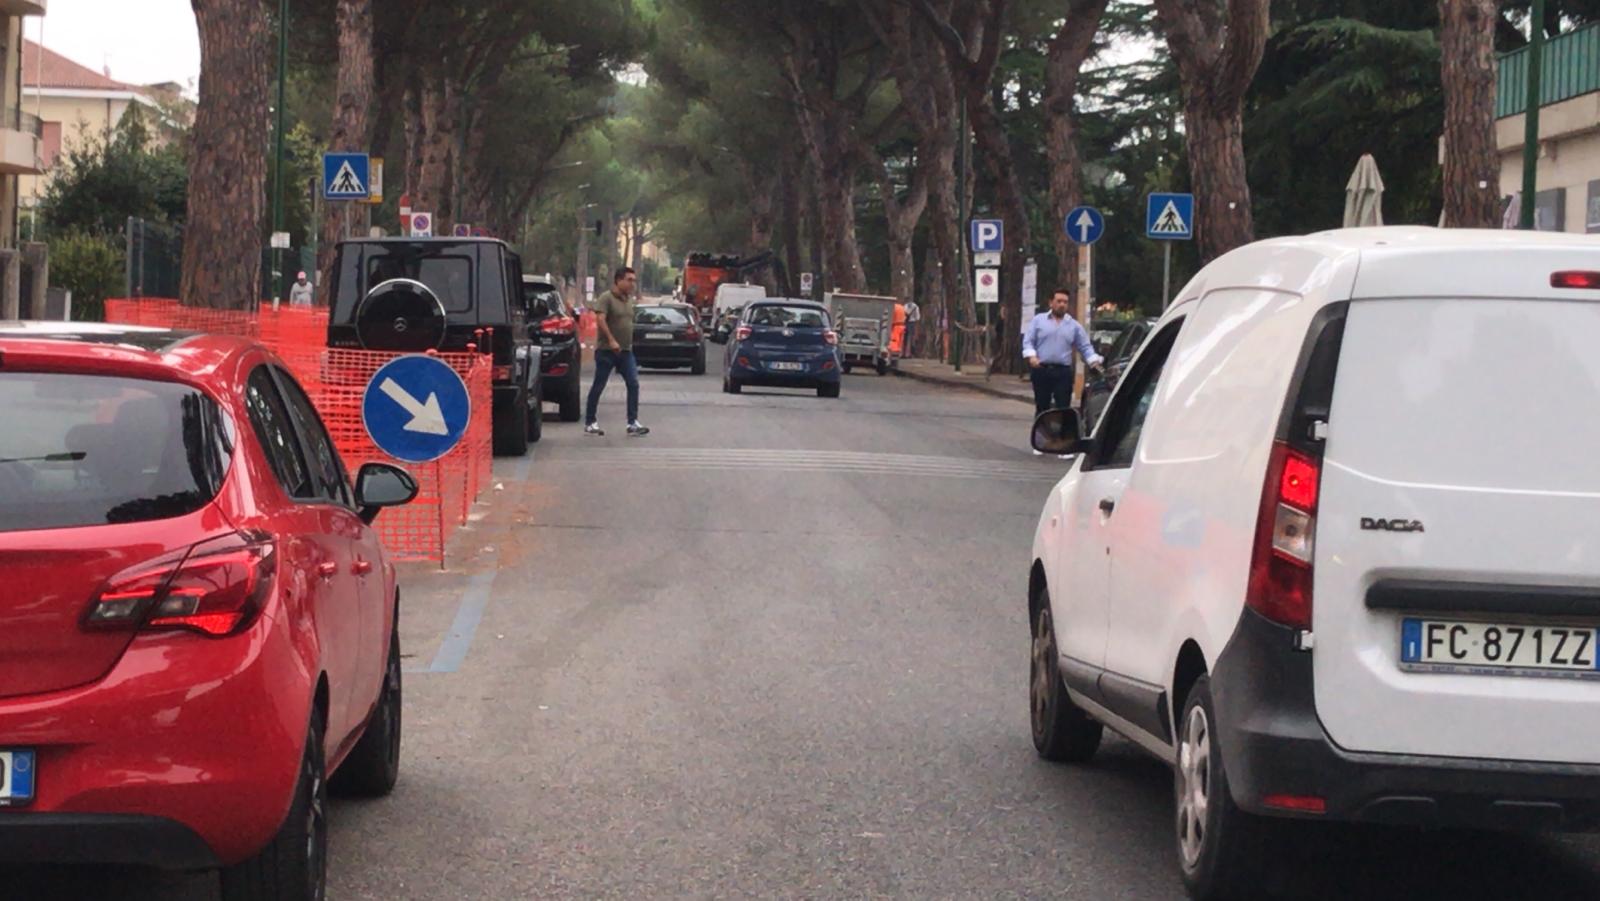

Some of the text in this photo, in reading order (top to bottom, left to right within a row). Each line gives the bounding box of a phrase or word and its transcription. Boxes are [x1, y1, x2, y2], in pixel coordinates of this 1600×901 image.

[978, 223, 998, 249] P
[1360, 517, 1425, 532] DACIA
[1427, 623, 1591, 666] FC 871ZZ
